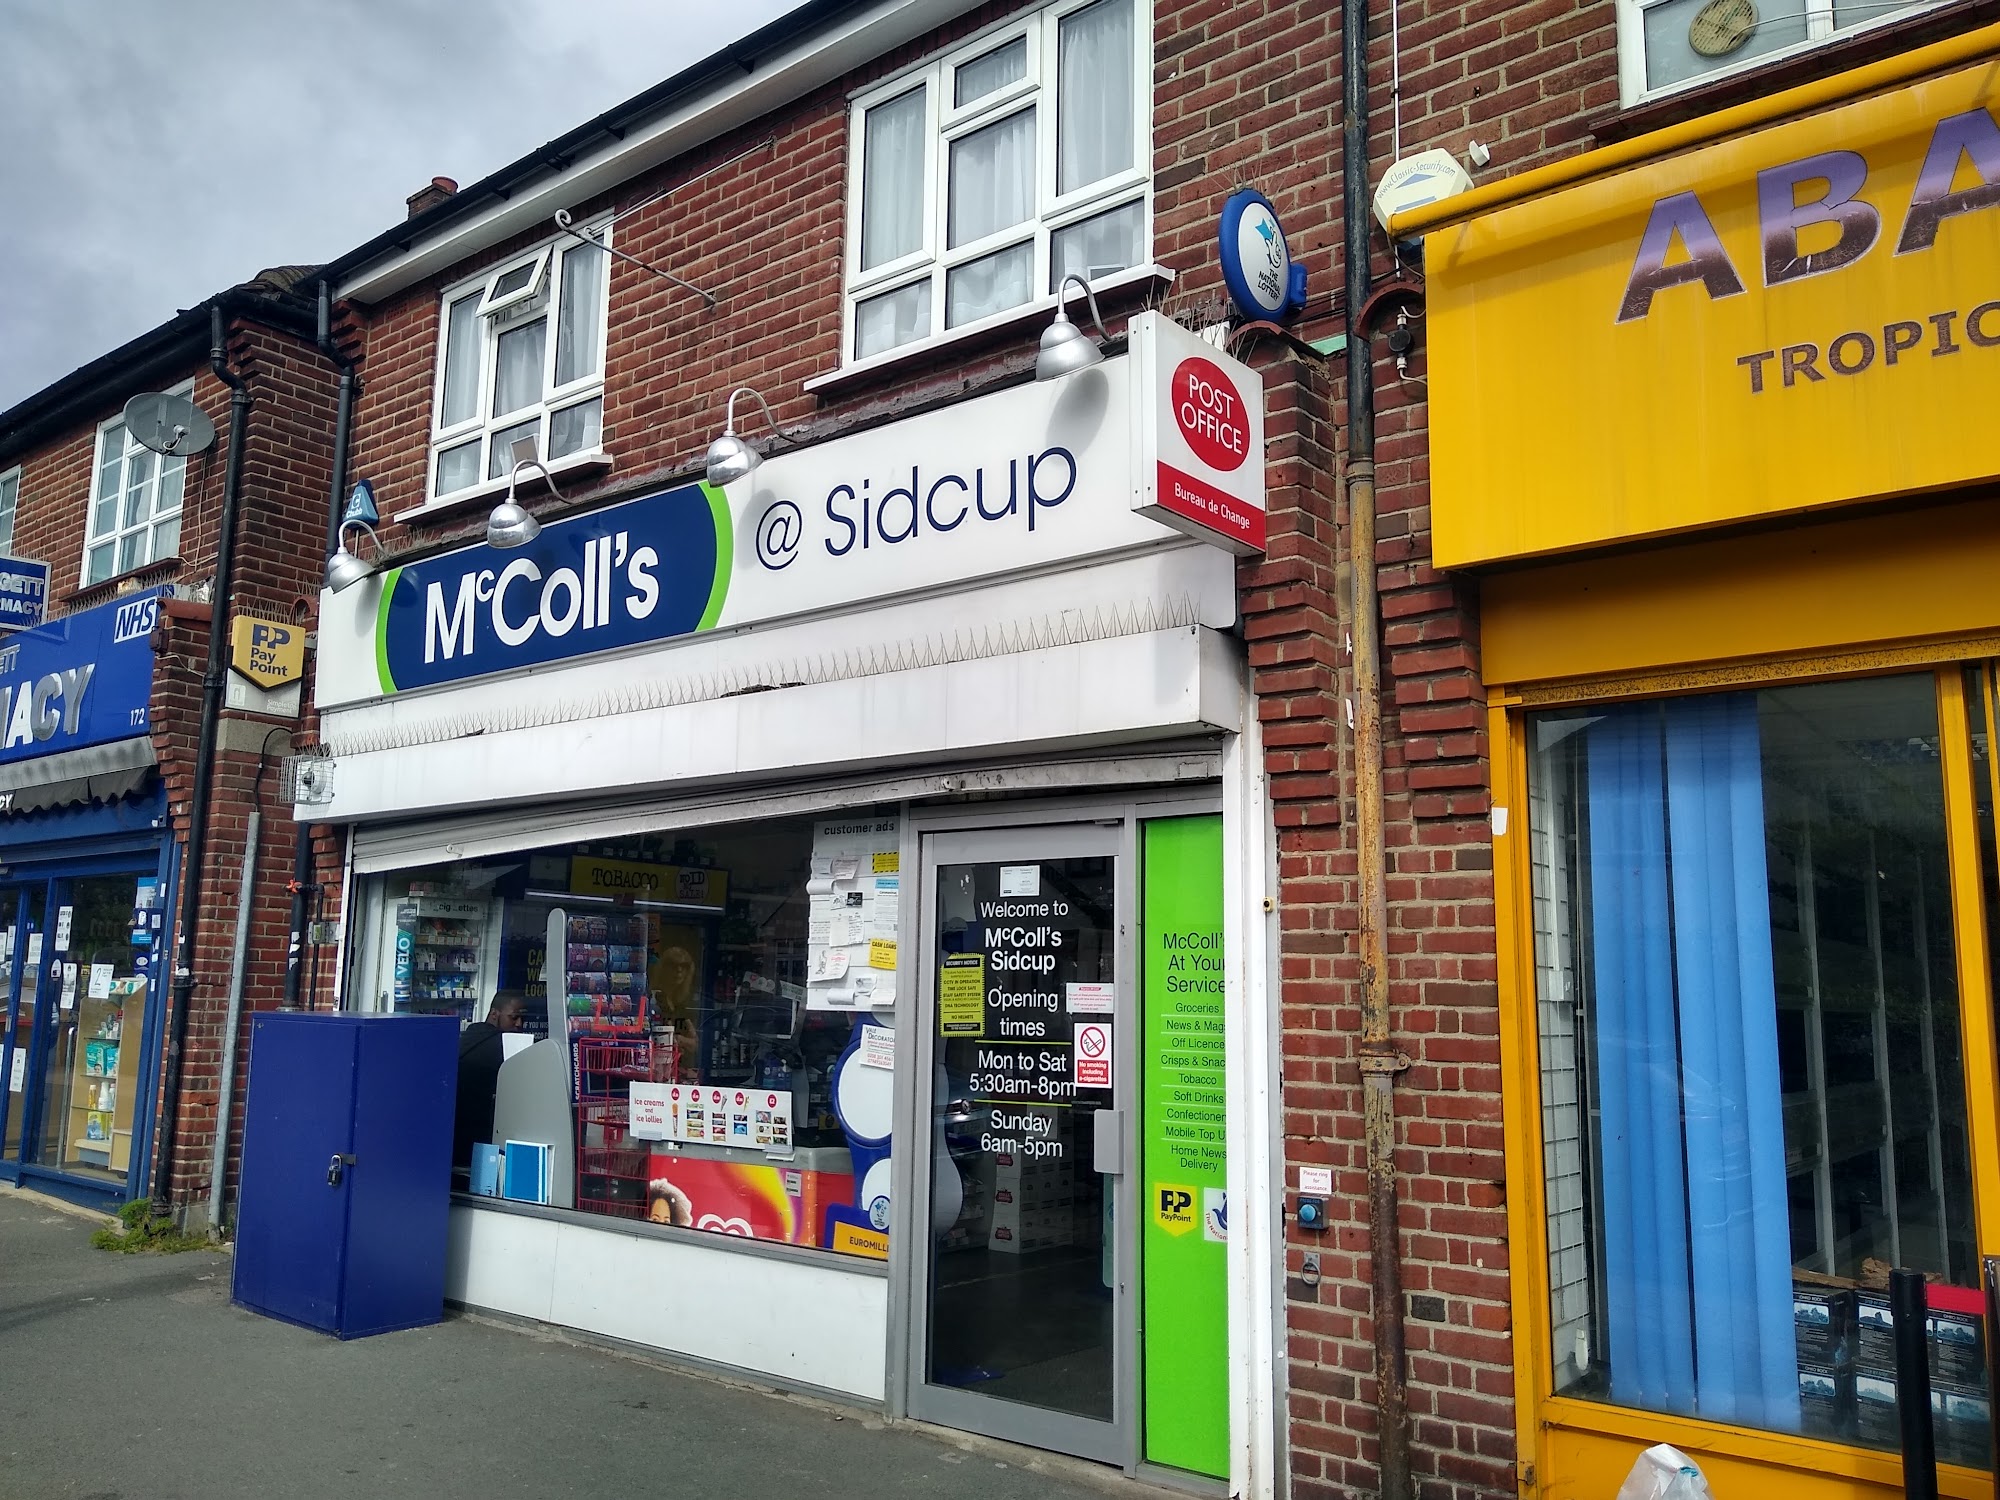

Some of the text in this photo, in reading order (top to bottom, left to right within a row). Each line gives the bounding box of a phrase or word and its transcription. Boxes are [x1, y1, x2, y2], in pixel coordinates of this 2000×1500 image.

[1377, 160, 1456, 199] www.Classic-Security.com
[1614, 106, 2000, 325] ABA
[1258, 270, 1281, 296] NATIONAL
[1269, 269, 1279, 282] THE
[1257, 279, 1279, 302] LOTTERY
[1188, 373, 1235, 416] POST
[1181, 401, 1243, 456] OFFICE
[1174, 481, 1251, 531] Bureau de Change
[424, 530, 660, 664] McColl's
[824, 446, 1077, 556] Sidcup
[0, 599, 43, 617] MACY
[116, 599, 156, 642] NHS
[250, 647, 276, 664] Pay
[249, 659, 288, 677] Point
[0, 663, 95, 749] ACY
[130, 707, 145, 726] 172
[824, 821, 895, 836] customer ads
[592, 867, 659, 891] TOBACCO
[438, 903, 479, 912] cigettes
[980, 900, 1069, 918] Welcome to
[984, 927, 1062, 948] McColl's
[1163, 932, 1224, 950] McColl'
[397, 937, 411, 976] VELO
[990, 950, 1056, 975] Sidcup
[1168, 954, 1185, 971] At
[987, 989, 1059, 1013] Opening
[1175, 1002, 1219, 1014] Groceries
[999, 1020, 1046, 1037] times
[1166, 1019, 1193, 1031] News
[1194, 1020, 1202, 1031] &
[1171, 1037, 1225, 1050] Off Licence
[978, 1050, 1067, 1072] Mon to Sat
[1161, 1054, 1189, 1069] Crisps
[1190, 1056, 1199, 1067] &
[573, 1042, 581, 1100] SCRATCHCARDS
[1179, 1073, 1217, 1085] Tobacco
[969, 1073, 1076, 1099] 5:30am-8pm
[643, 1099, 665, 1107] creams
[1173, 1091, 1224, 1104] Soft Drinks
[646, 1115, 663, 1124] lollies
[990, 1110, 1053, 1135] Sunday
[1165, 1126, 1196, 1139] Mobile
[1198, 1128, 1216, 1142] Top
[980, 1132, 1064, 1158] 6am-5pm
[1171, 1144, 1227, 1159] Home News
[1180, 1157, 1218, 1172] Delivery
[1160, 1211, 1191, 1223] PayPoint
